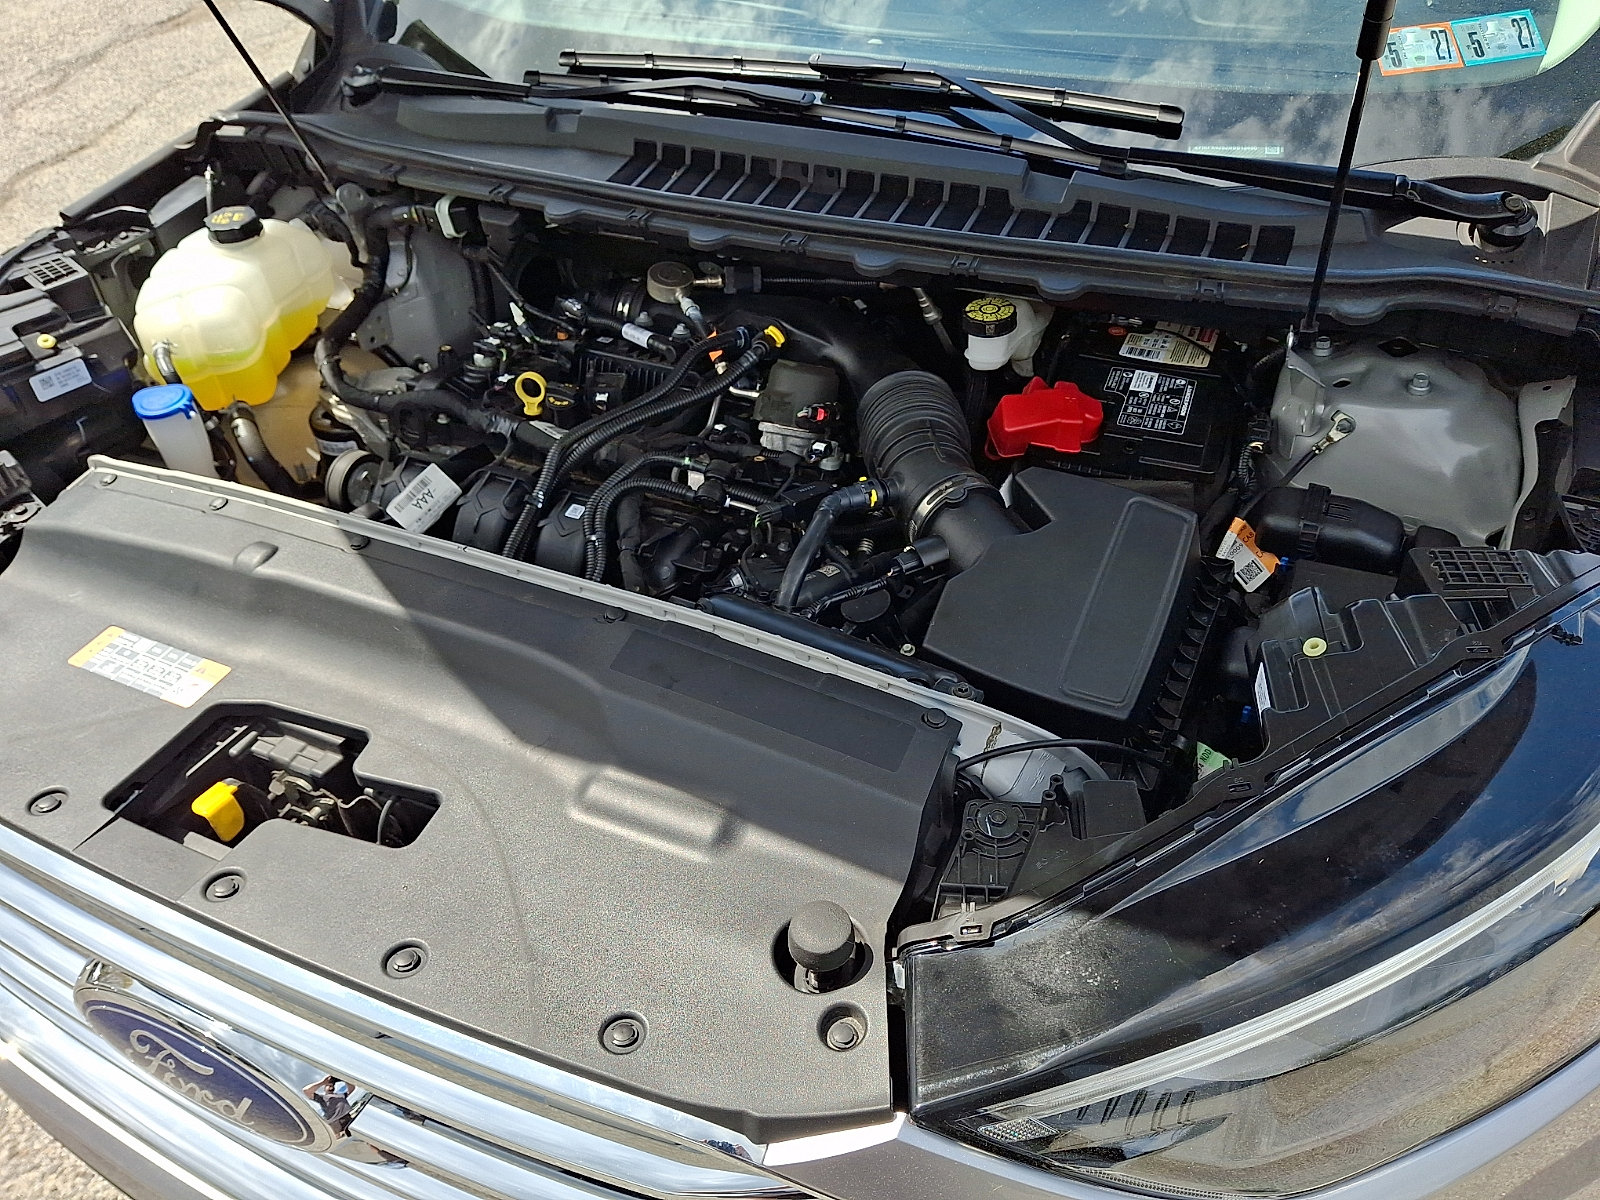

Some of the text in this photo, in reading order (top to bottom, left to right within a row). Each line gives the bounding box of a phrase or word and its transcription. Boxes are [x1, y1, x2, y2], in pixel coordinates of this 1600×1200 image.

[1387, 42, 1402, 68] 5
[1430, 30, 1451, 61] 27
[1467, 32, 1485, 58] 5
[1511, 17, 1535, 49] 27
[411, 489, 434, 510] AAA
[129, 1029, 255, 1126] Ford
